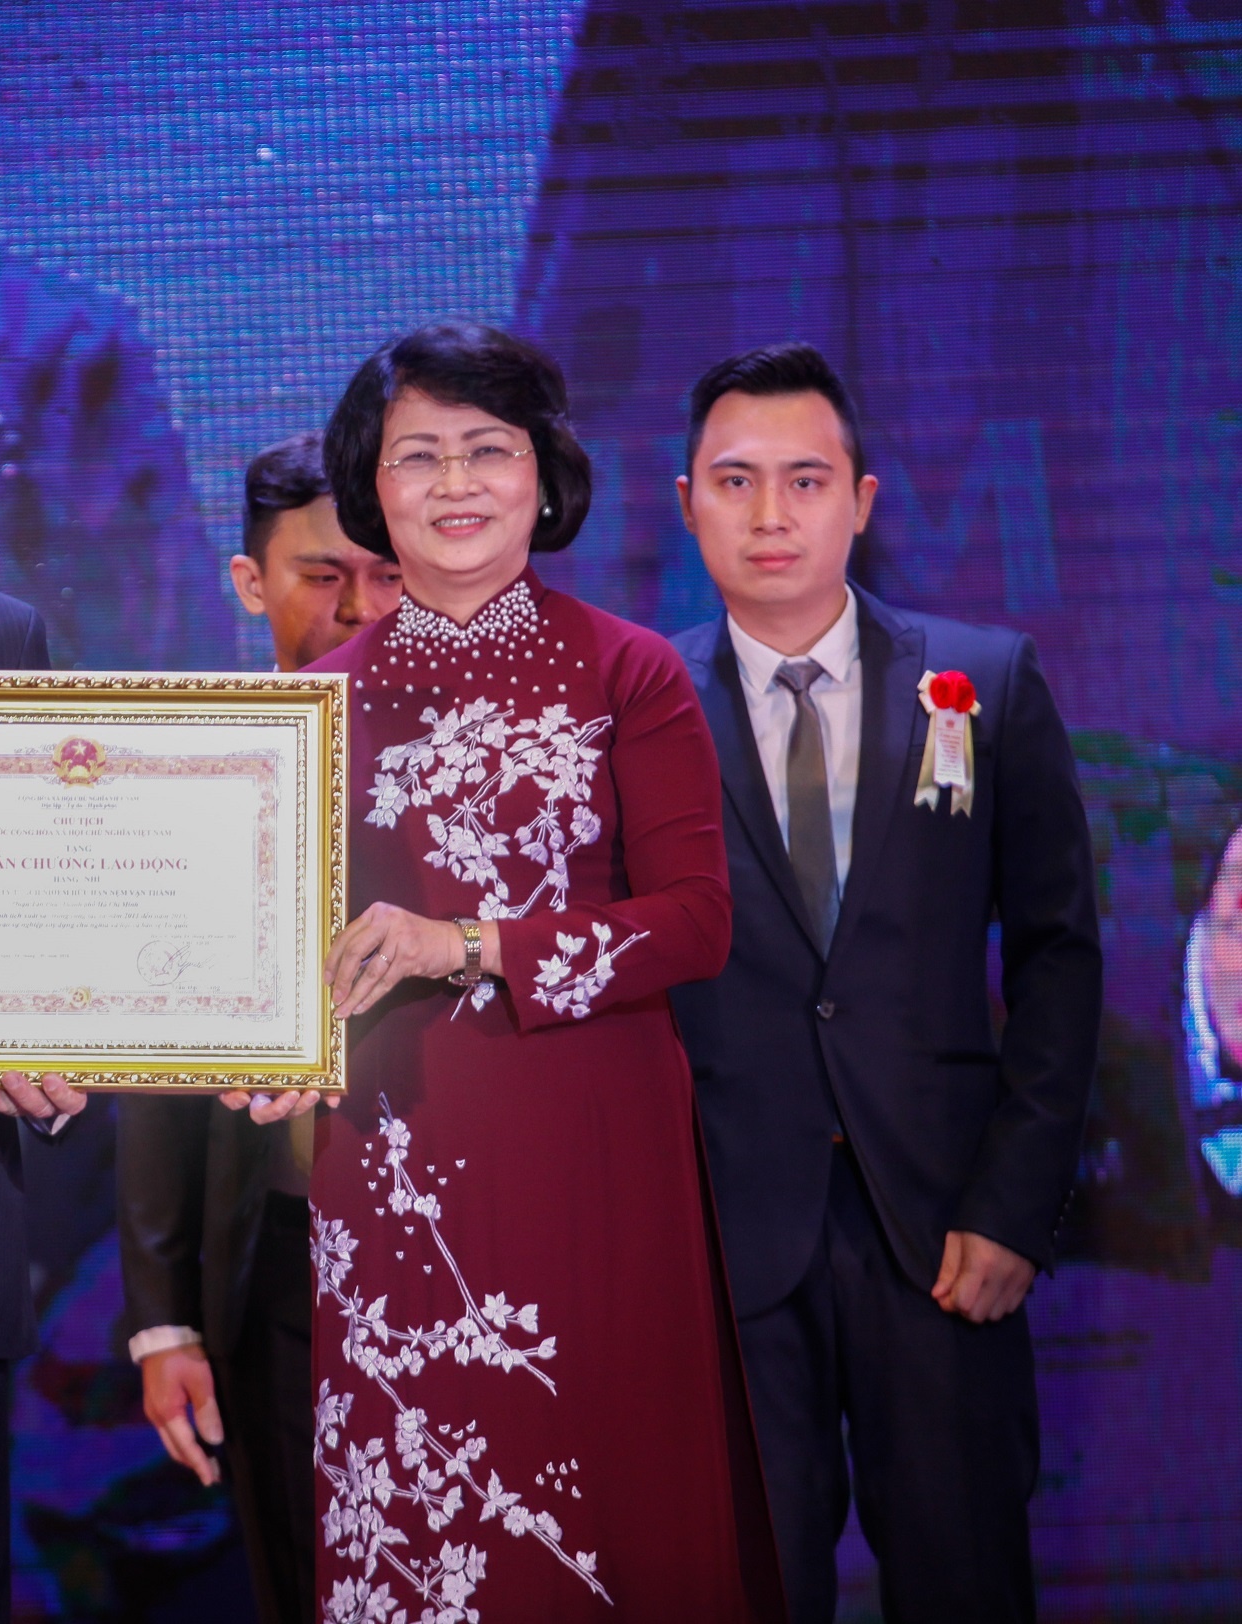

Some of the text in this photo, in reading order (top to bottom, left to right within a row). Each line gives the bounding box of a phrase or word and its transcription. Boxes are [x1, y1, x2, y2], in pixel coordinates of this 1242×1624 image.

[78, 816, 104, 827] TỊCH
[21, 855, 96, 870] CHƯƠNG
[100, 857, 136, 870] LAO
[140, 855, 188, 873] ĐỘNG
